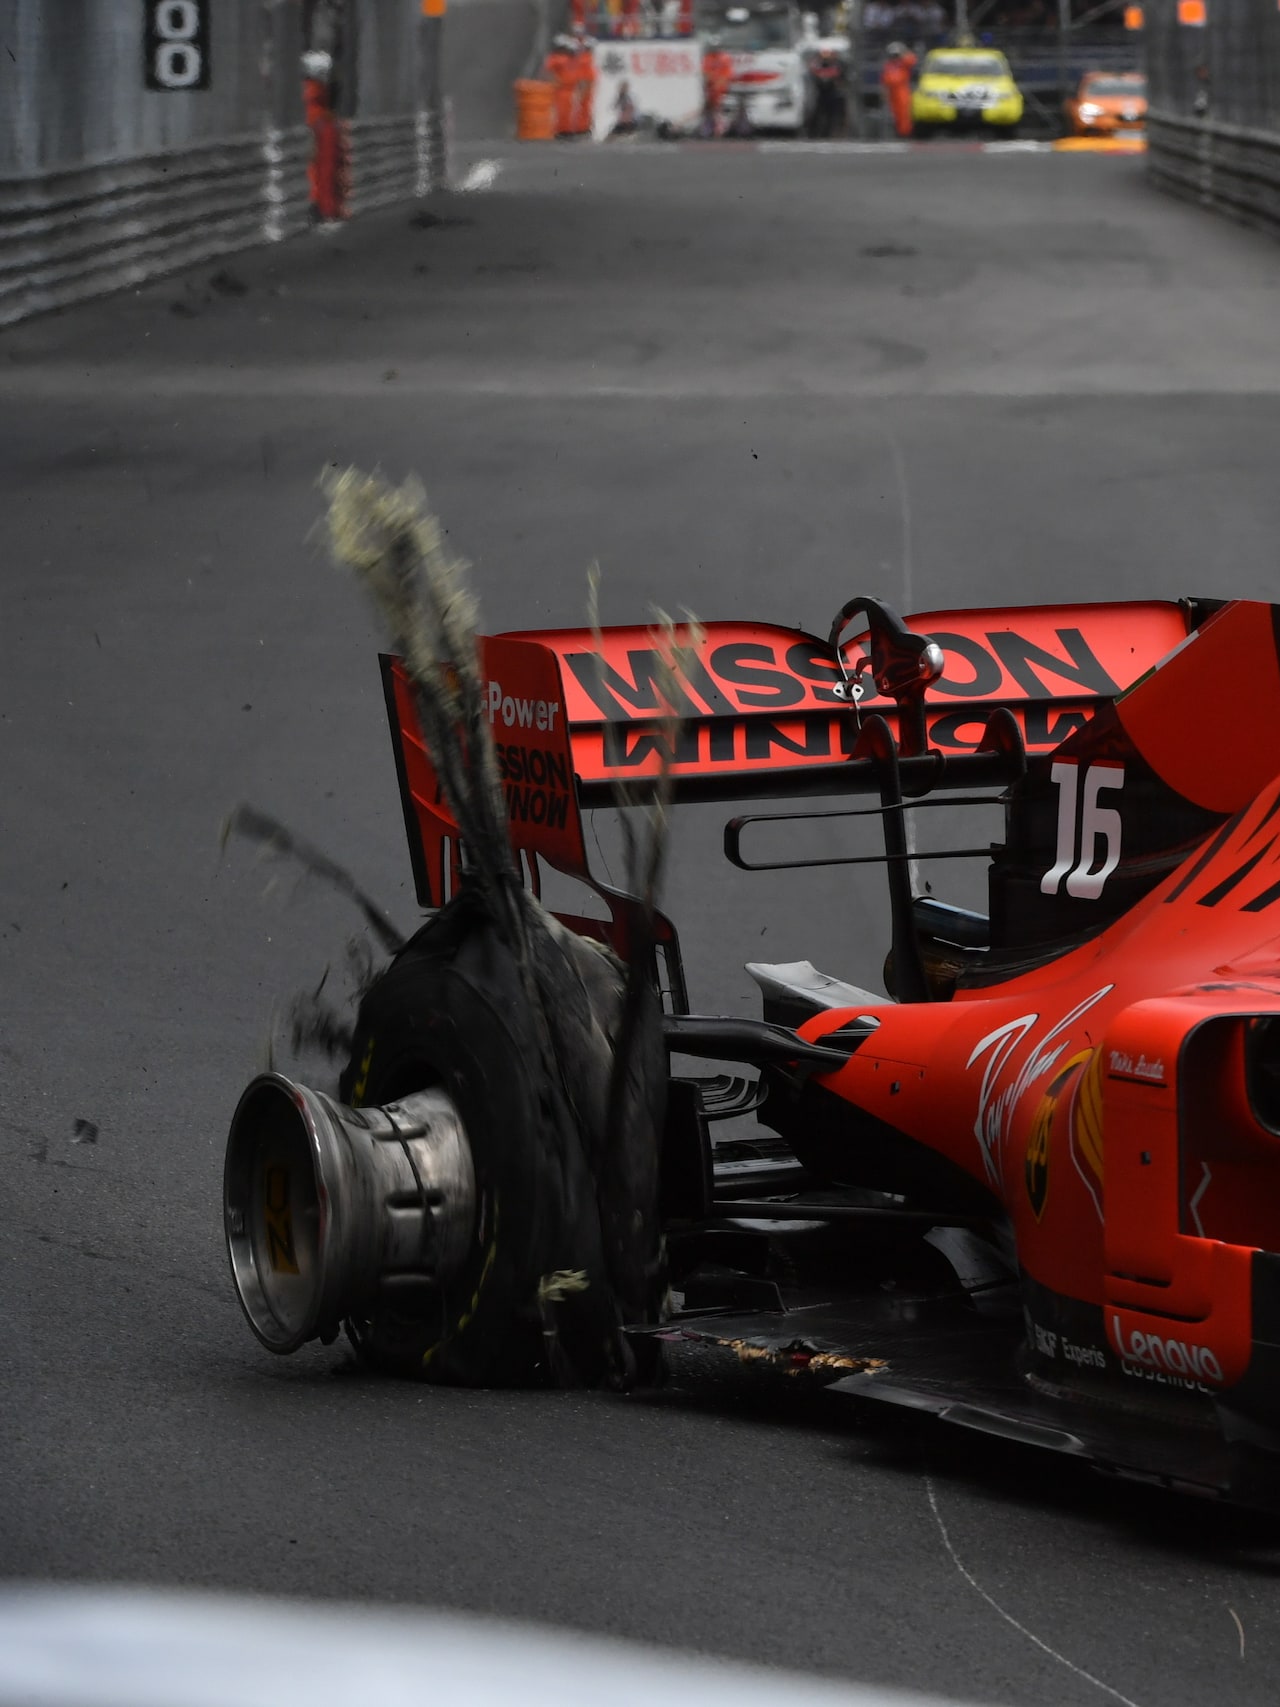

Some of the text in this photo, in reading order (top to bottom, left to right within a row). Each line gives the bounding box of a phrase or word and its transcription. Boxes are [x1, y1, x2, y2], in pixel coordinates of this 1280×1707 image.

[563, 626, 1123, 721] MISSON
[477, 680, 559, 732] -Power
[495, 743, 569, 791] SSION
[506, 784, 569, 830] NOW
[1040, 755, 1126, 901] 16
[1061, 1335, 1107, 1369] Experis
[1112, 1314, 1224, 1382] Lenovo
